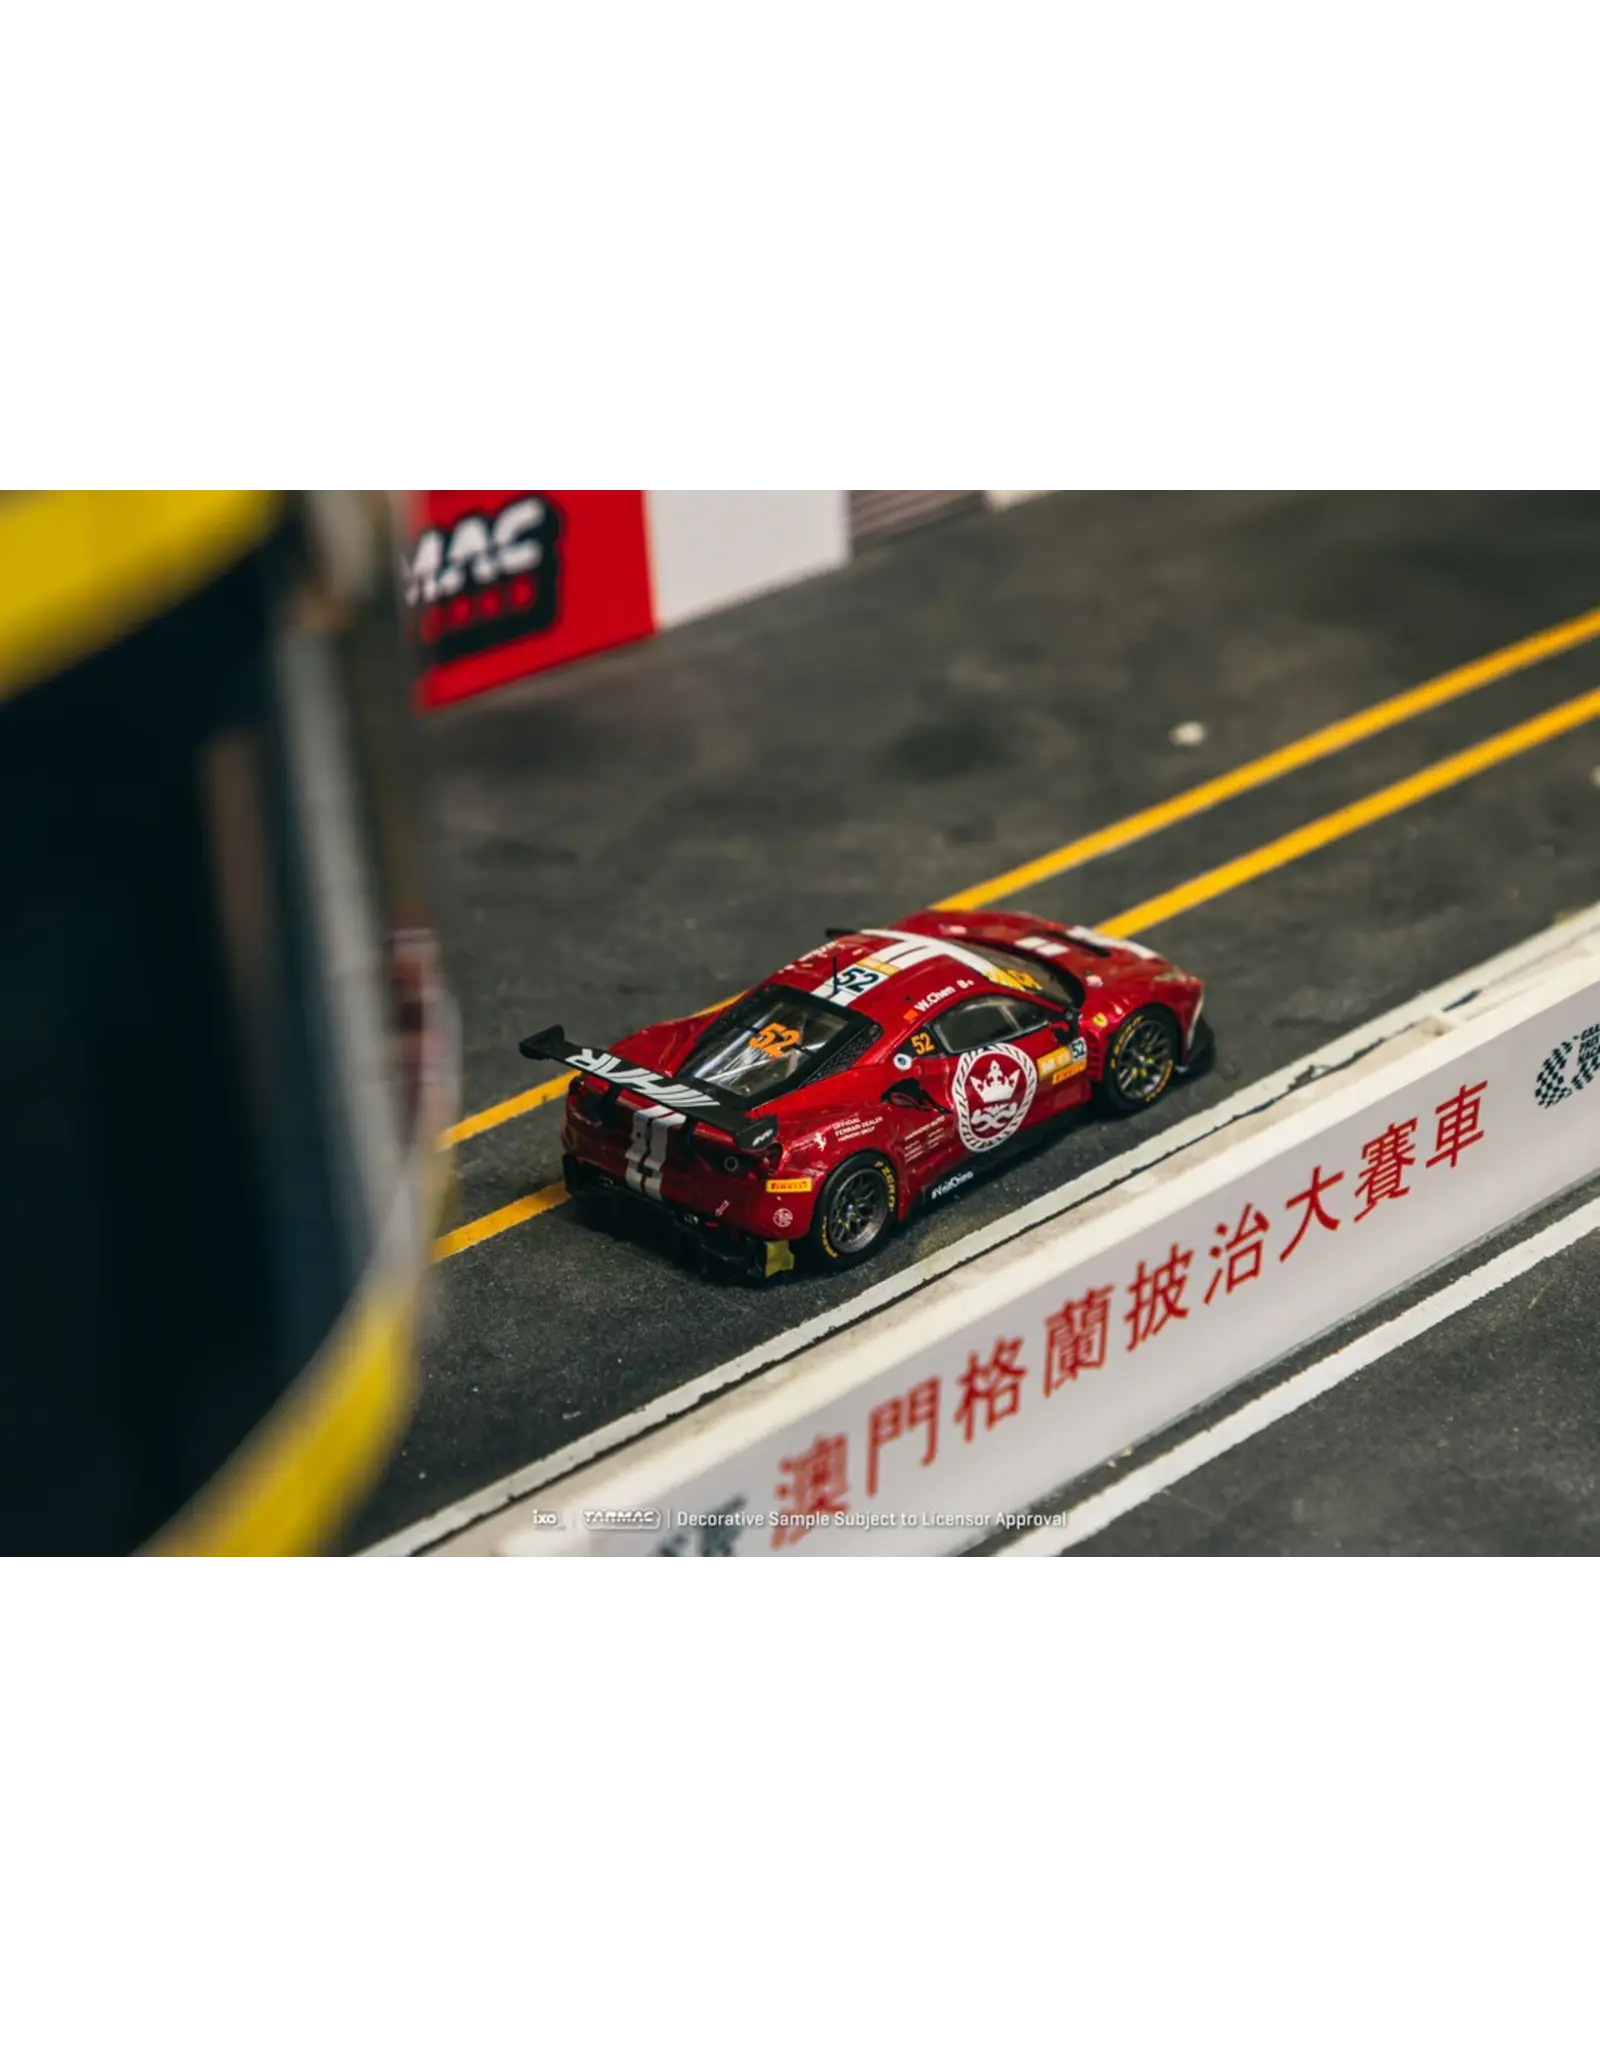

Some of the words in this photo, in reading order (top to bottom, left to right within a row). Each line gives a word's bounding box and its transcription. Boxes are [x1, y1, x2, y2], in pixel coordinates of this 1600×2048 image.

[837, 966, 880, 993] 52
[748, 1022, 801, 1059] 52
[910, 1032, 936, 1055] 52
[1071, 1040, 1087, 1059] 52
[770, 1080, 1488, 1551] 澳門格蘭披治大賽車
